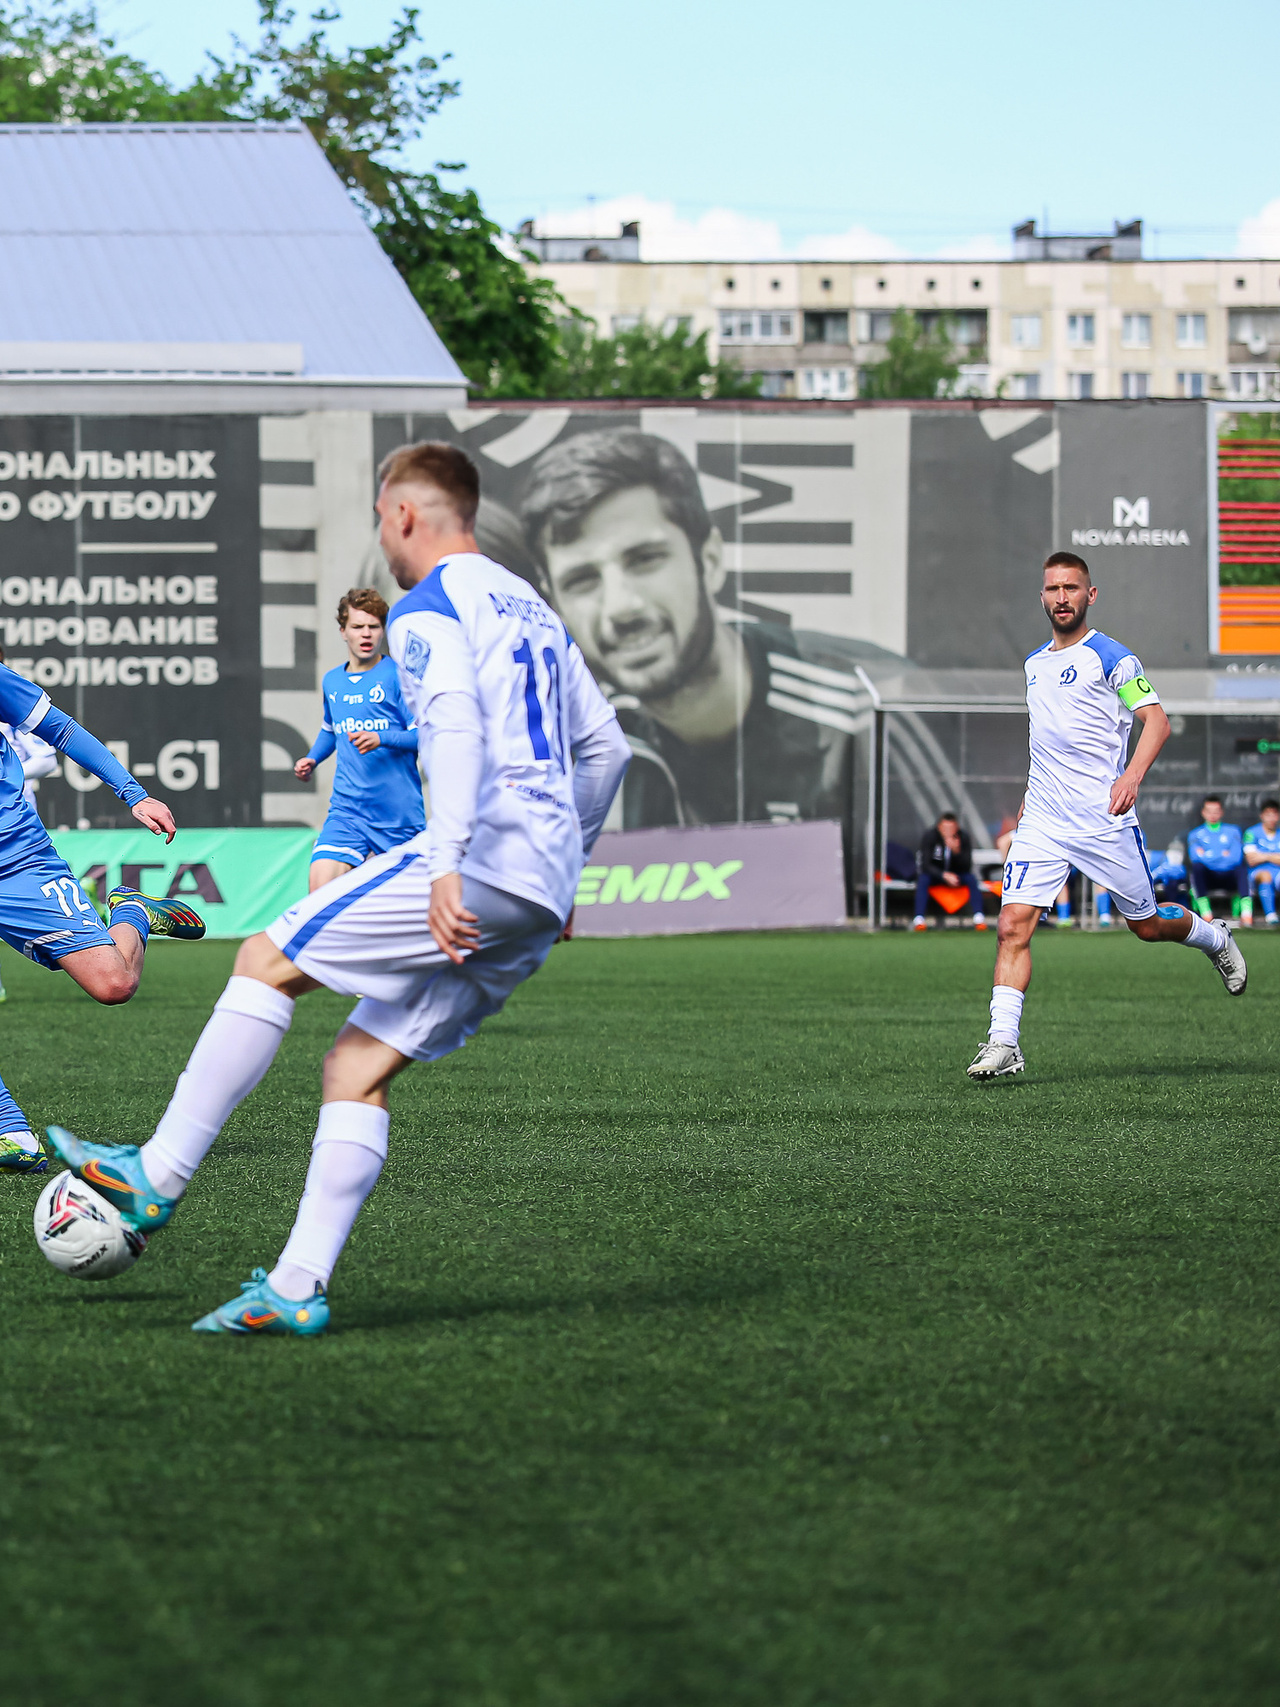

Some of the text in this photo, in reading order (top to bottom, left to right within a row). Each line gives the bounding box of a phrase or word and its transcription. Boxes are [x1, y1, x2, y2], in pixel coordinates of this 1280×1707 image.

[28, 490, 217, 522] ФУТБОЛУ
[1071, 529, 1191, 546] NOVA ARENA
[1137, 678, 1151, 693] C
[573, 860, 744, 906] EMIX
[1004, 862, 1030, 891] 37
[40, 877, 91, 918] 72
